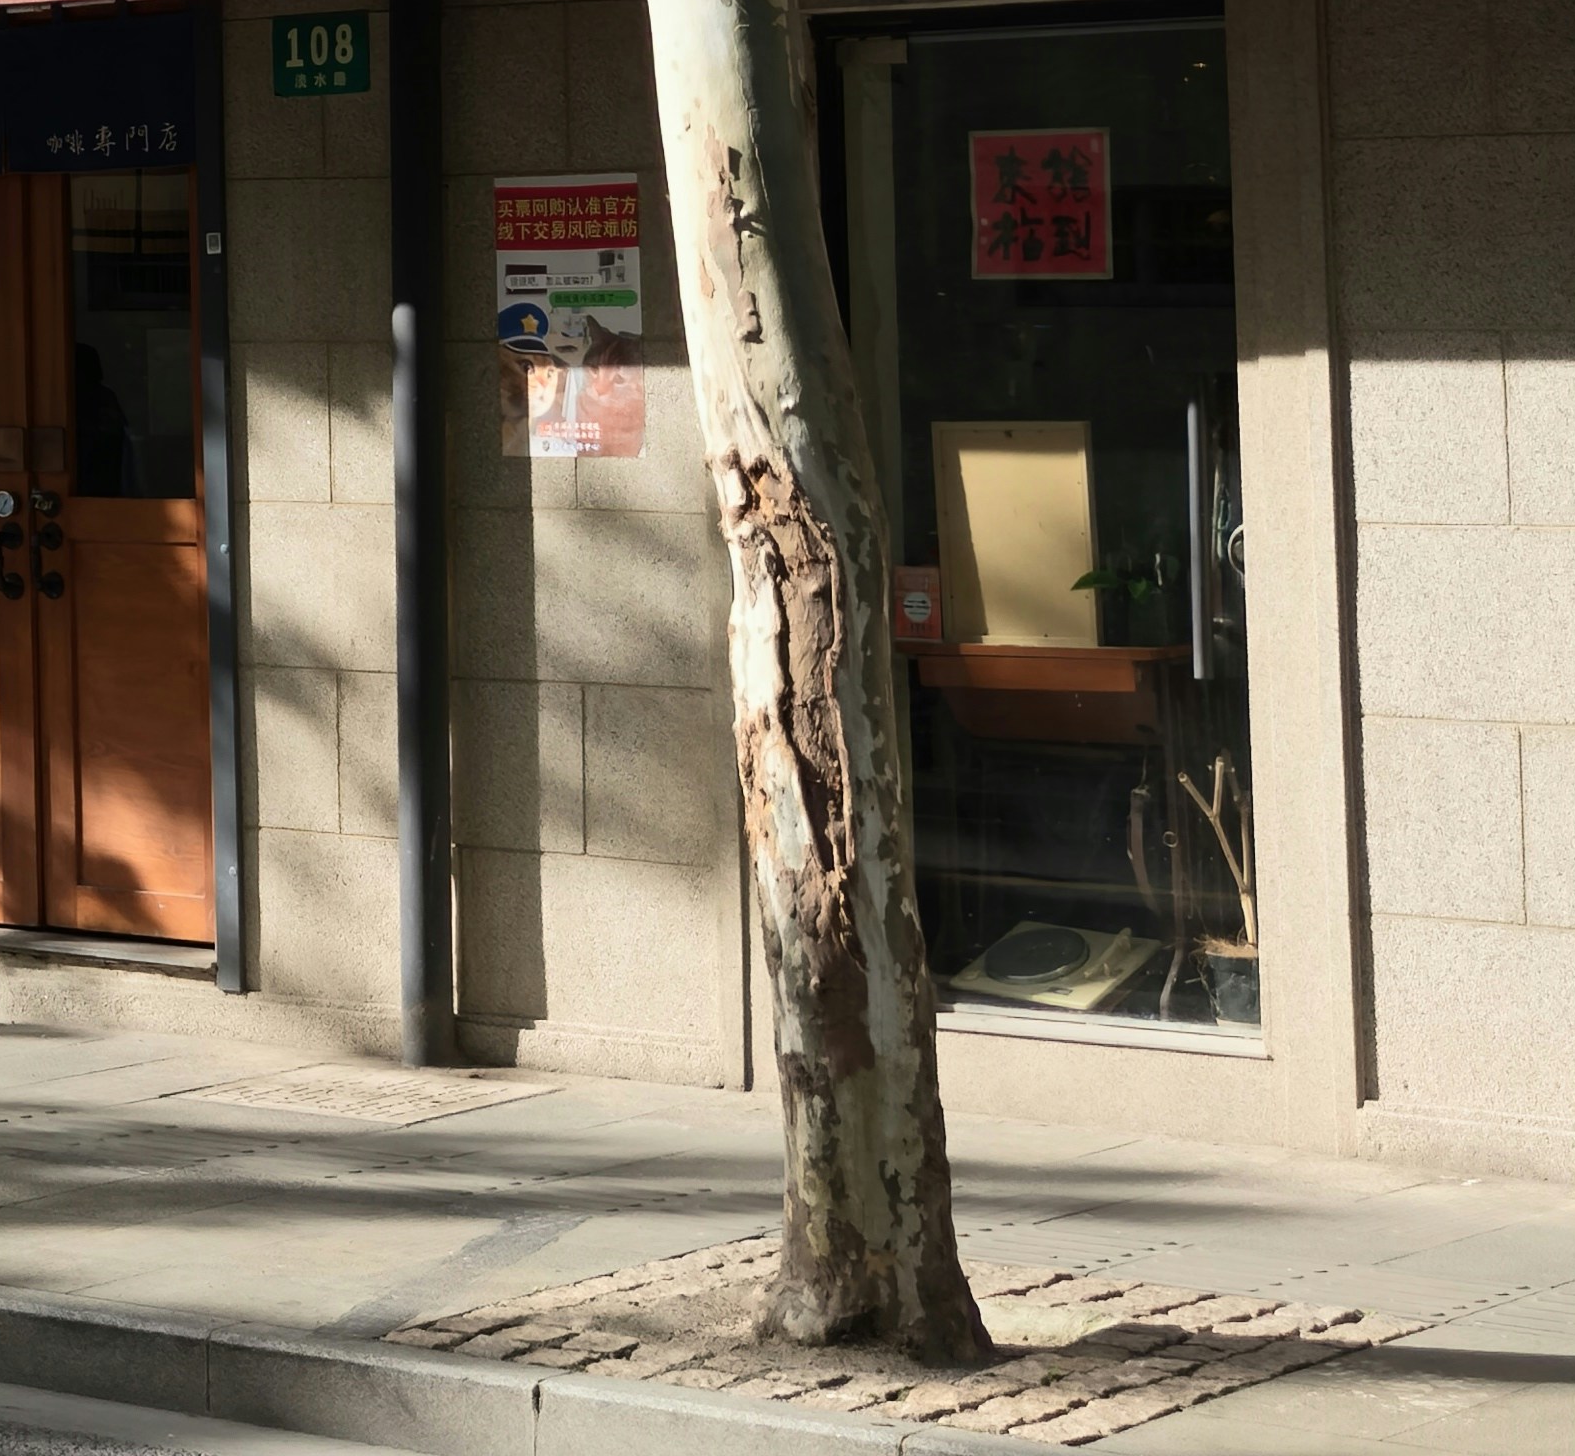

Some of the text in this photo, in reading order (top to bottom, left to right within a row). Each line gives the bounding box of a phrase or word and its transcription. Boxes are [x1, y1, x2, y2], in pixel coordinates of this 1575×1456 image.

[286, 24, 354, 68] 108
[498, 195, 637, 218] 买票网购认准官方
[497, 219, 638, 241] 线下交易风险难防
